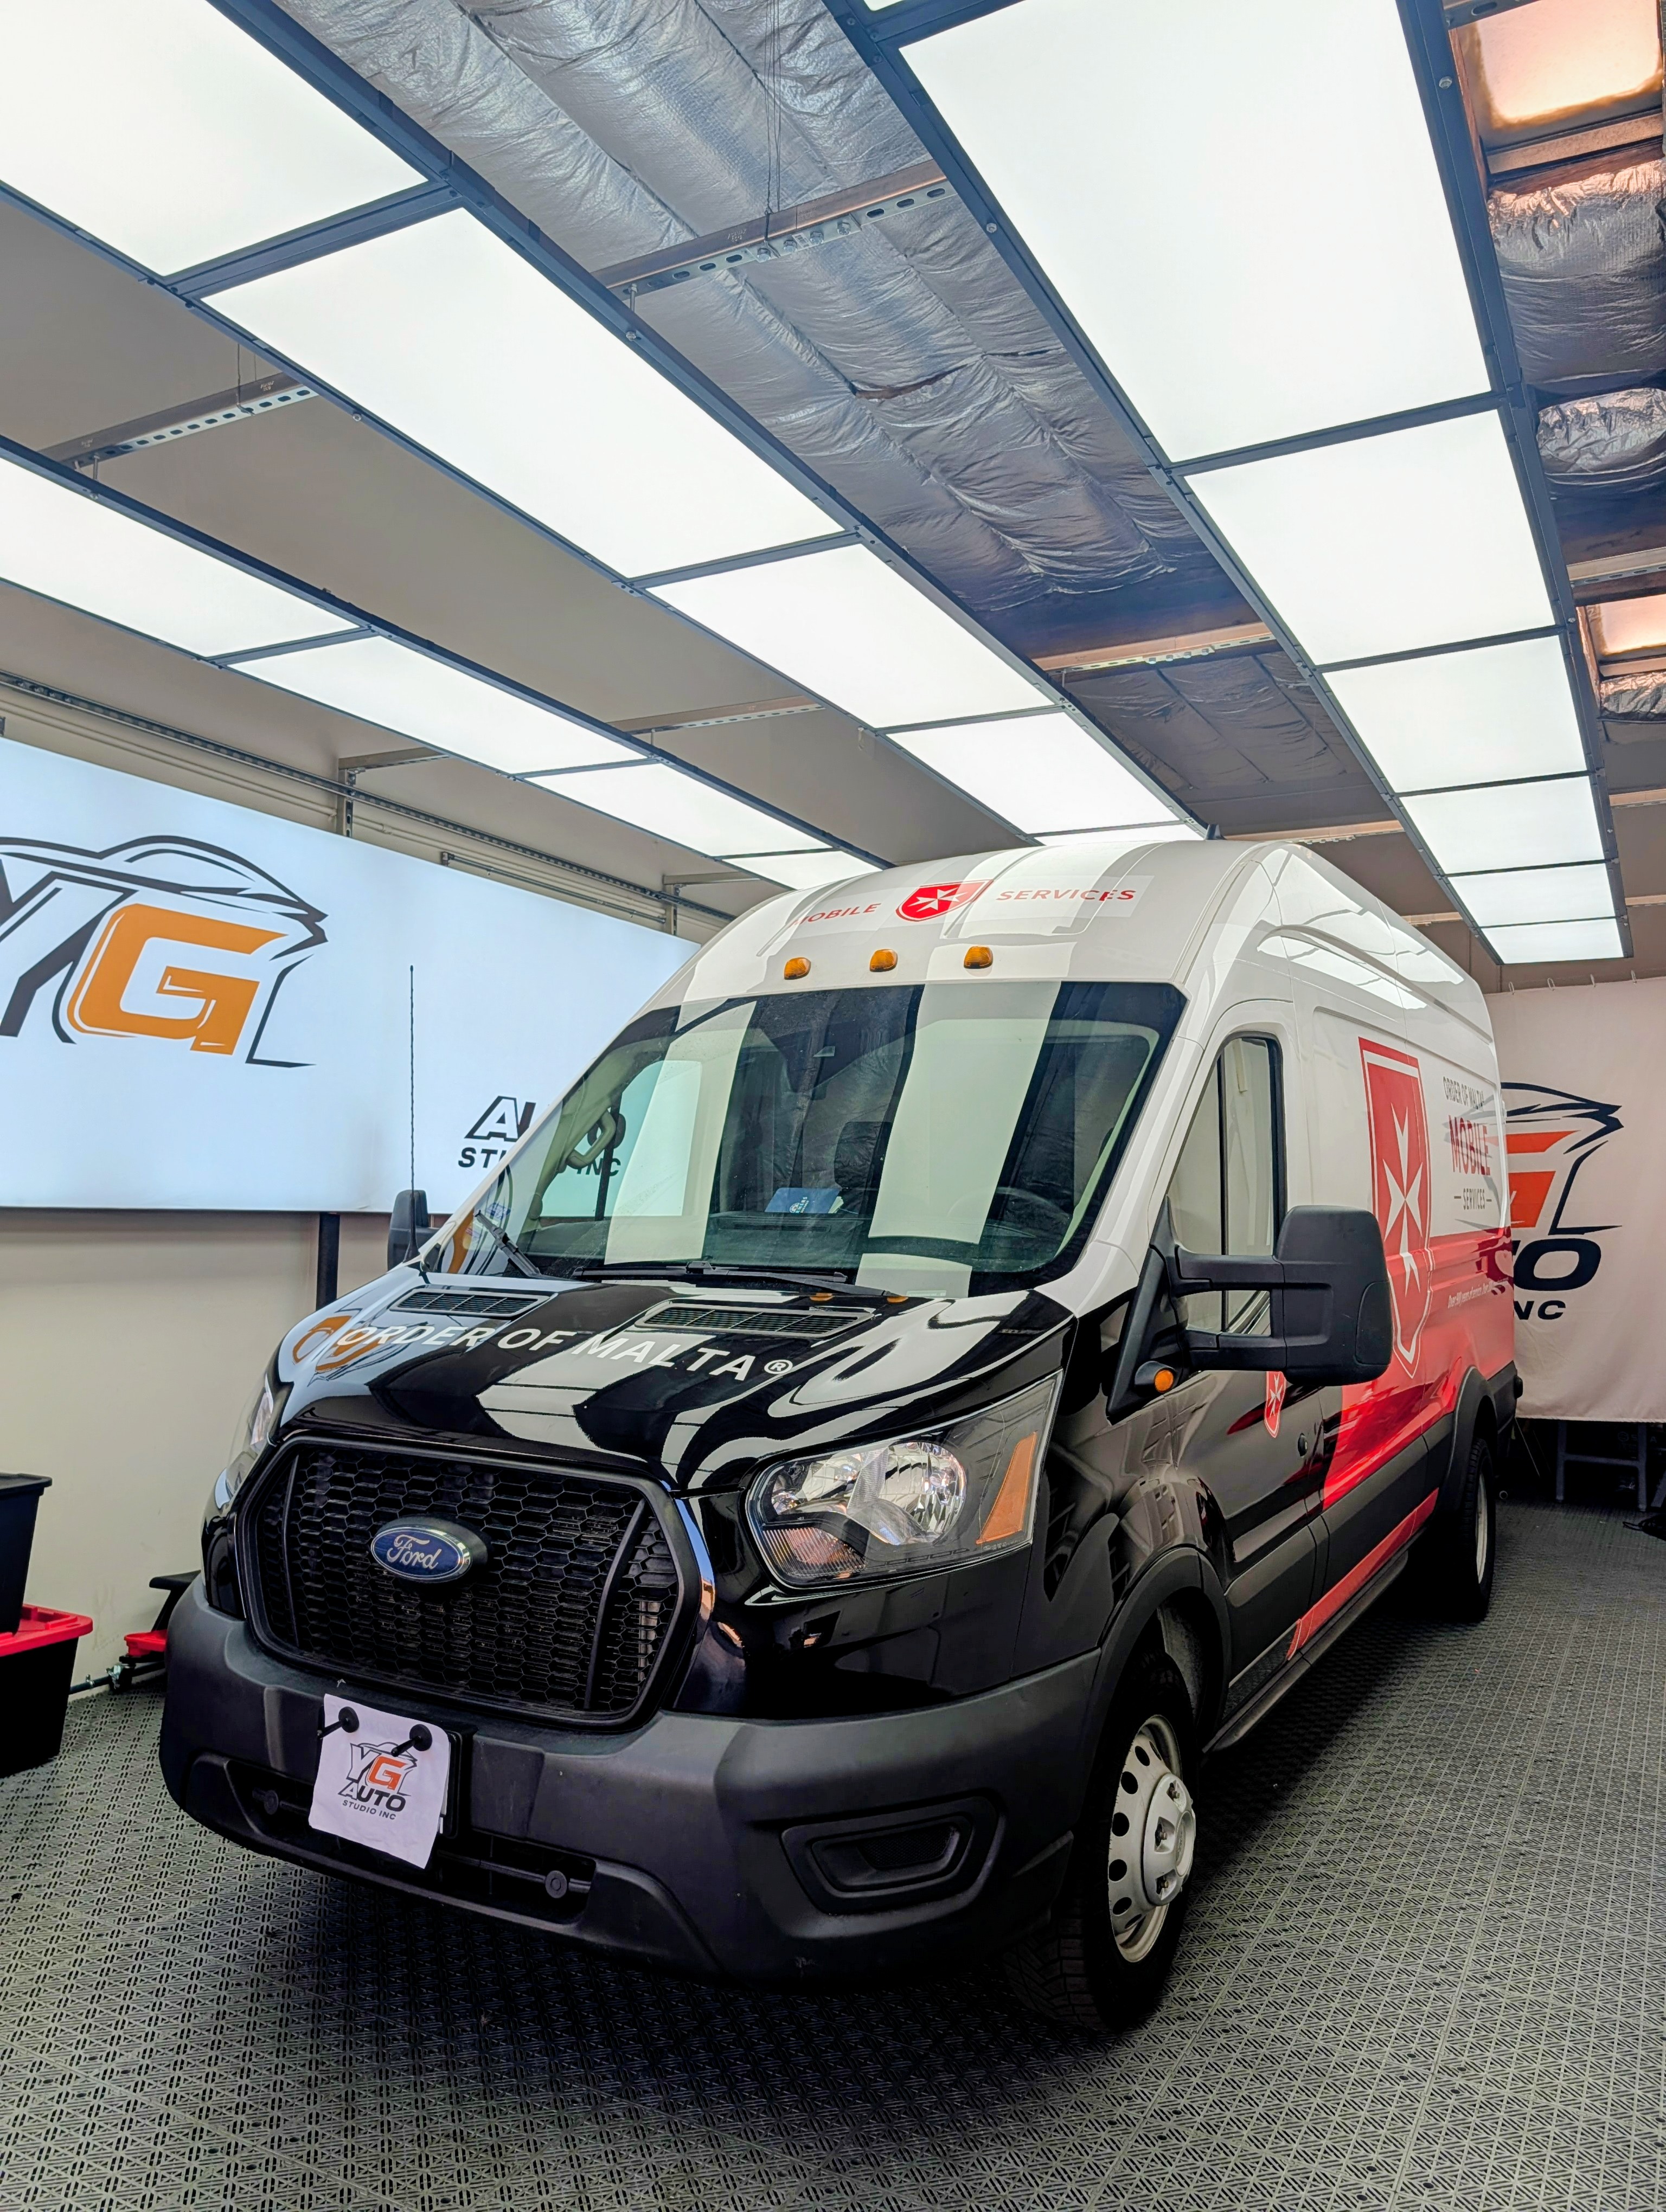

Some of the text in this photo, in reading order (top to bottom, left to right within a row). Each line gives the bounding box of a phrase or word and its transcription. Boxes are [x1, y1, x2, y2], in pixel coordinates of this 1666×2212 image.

[996, 889, 1137, 901] SERVICES
[1443, 1076, 1463, 1105] ORDER
[1462, 1083, 1469, 1107] OF
[1448, 1115, 1491, 1175] MOBILE
[1463, 1188, 1485, 1210] SERVICES
[1514, 1300, 1566, 1320] NC
[337, 1326, 496, 1346] ORDER
[497, 1329, 578, 1351] OF
[387, 1534, 441, 1569] Ford
[337, 1781, 406, 1812] AUTO
[342, 1800, 396, 1820] STUDIO INC
